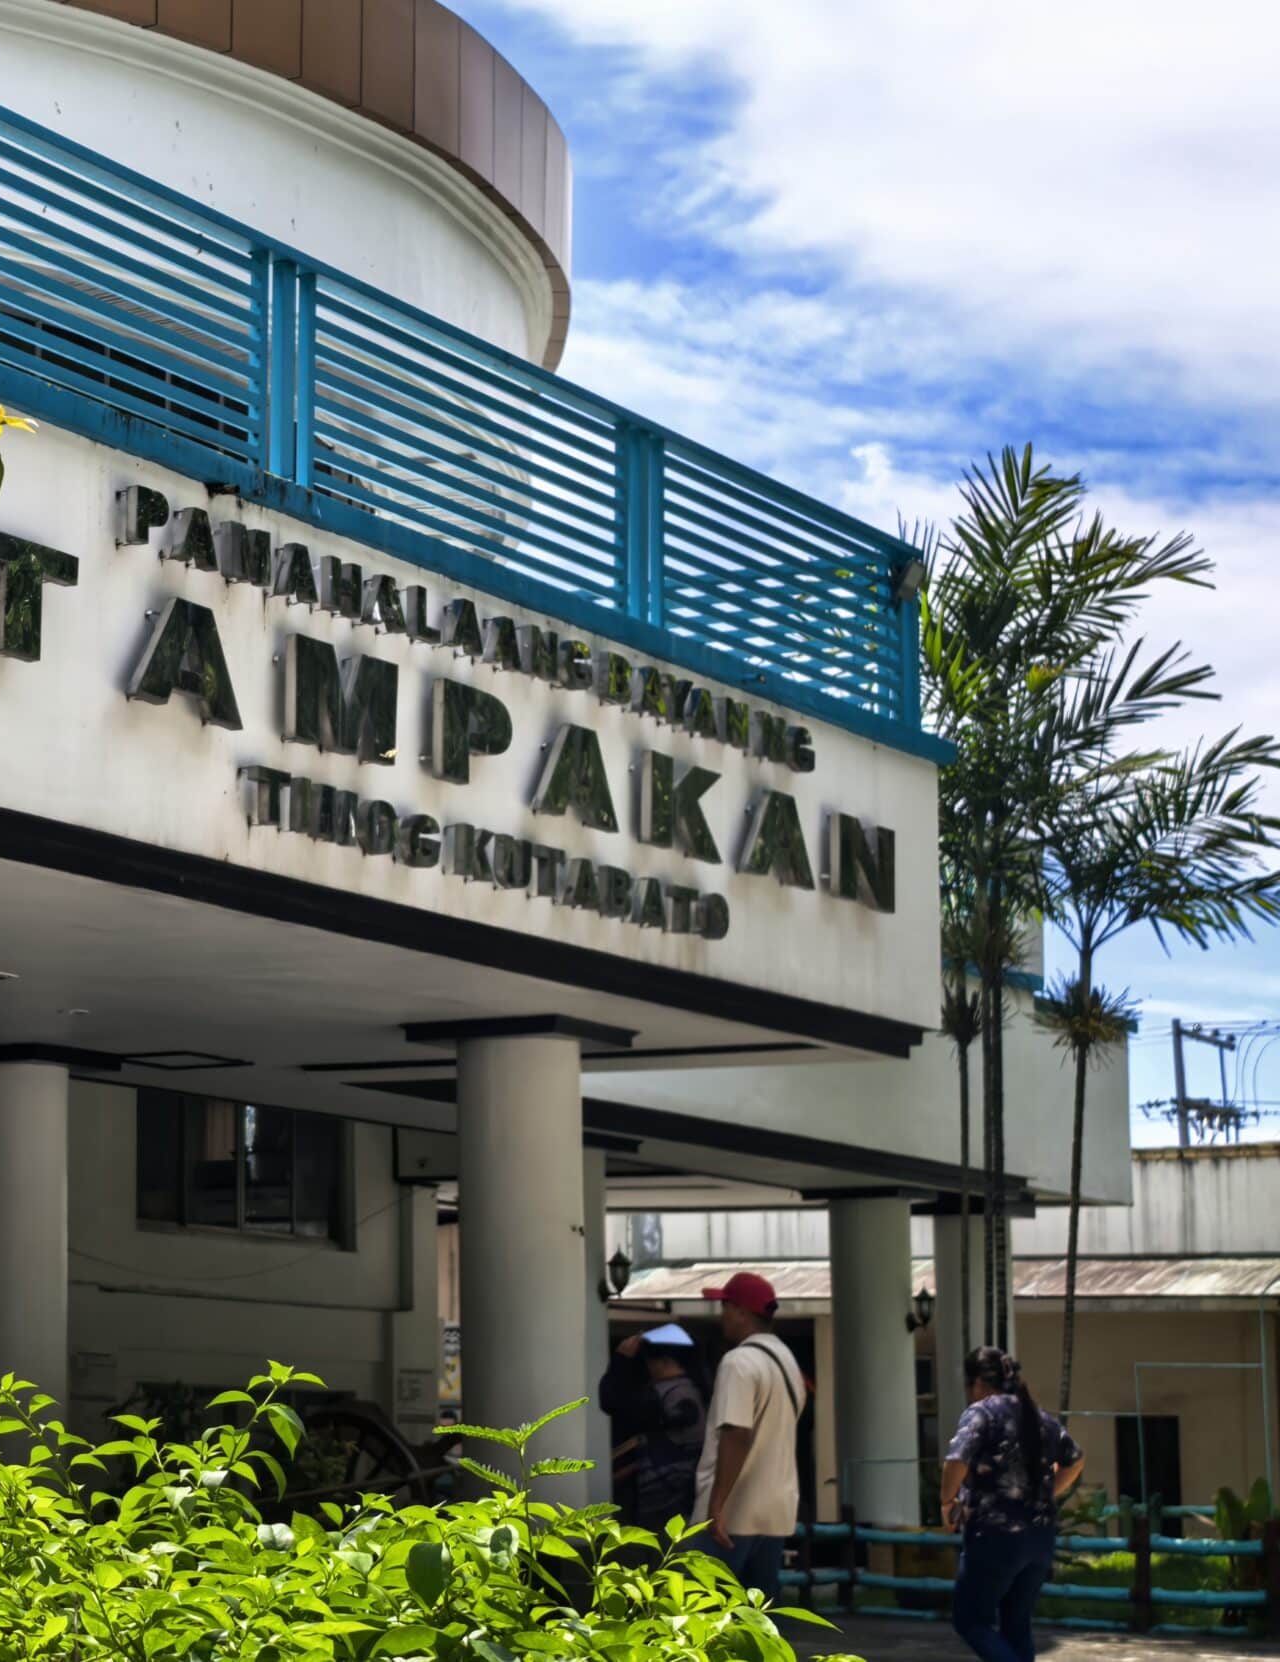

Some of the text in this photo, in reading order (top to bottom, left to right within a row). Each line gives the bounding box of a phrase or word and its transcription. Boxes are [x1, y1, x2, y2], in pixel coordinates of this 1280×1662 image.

[754, 711, 815, 772] NG
[247, 765, 730, 940] TIMOG KUTABATO
